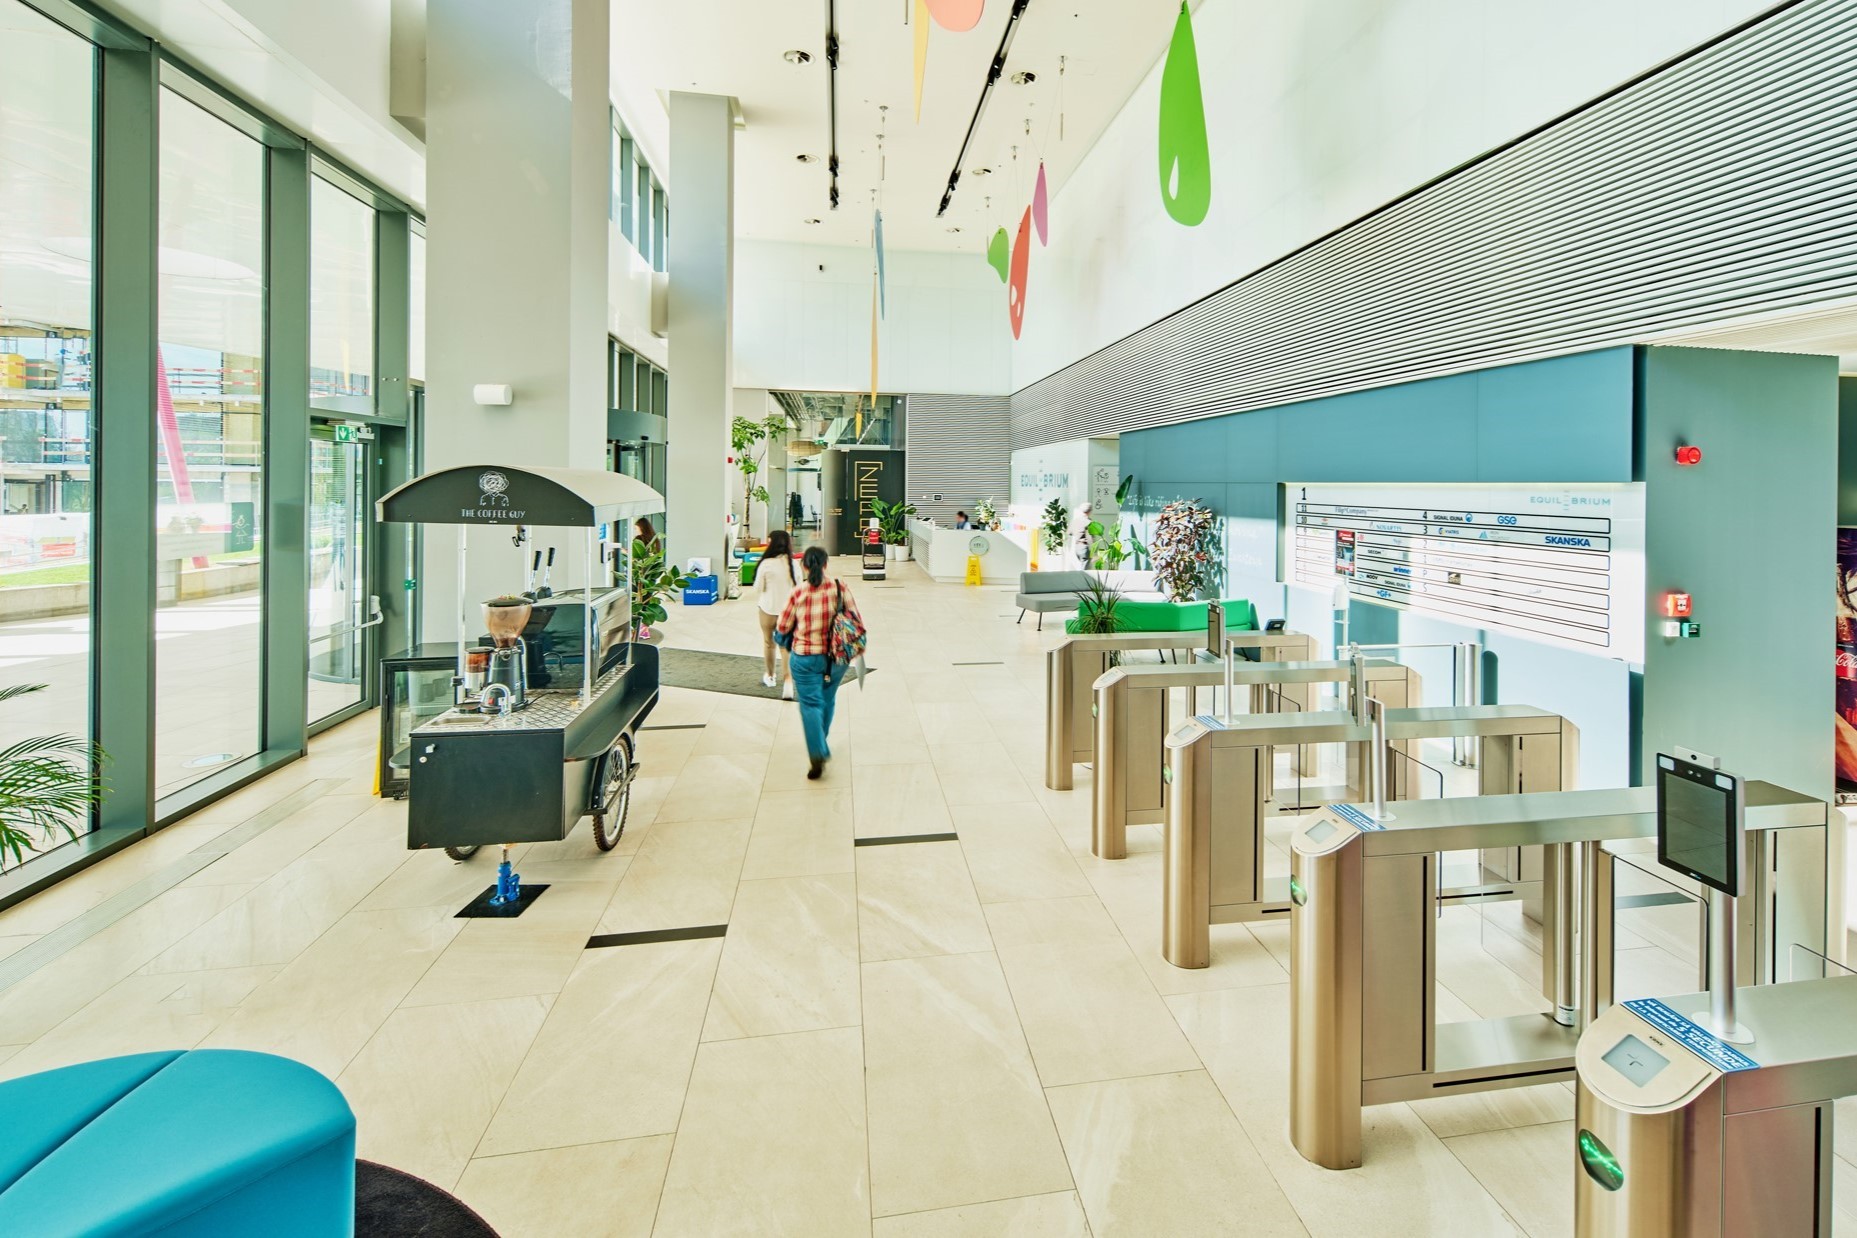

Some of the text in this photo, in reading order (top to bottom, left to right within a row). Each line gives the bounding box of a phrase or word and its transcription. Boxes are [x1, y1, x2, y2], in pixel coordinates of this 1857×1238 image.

[1301, 487, 1307, 501] 1
[461, 509, 526, 519] THE COFFEE GUY
[1422, 511, 1428, 519] 4
[1422, 525, 1428, 534] 3
[1545, 535, 1591, 548] SKANSKA
[1685, 1033, 1745, 1068] SECUNDE
